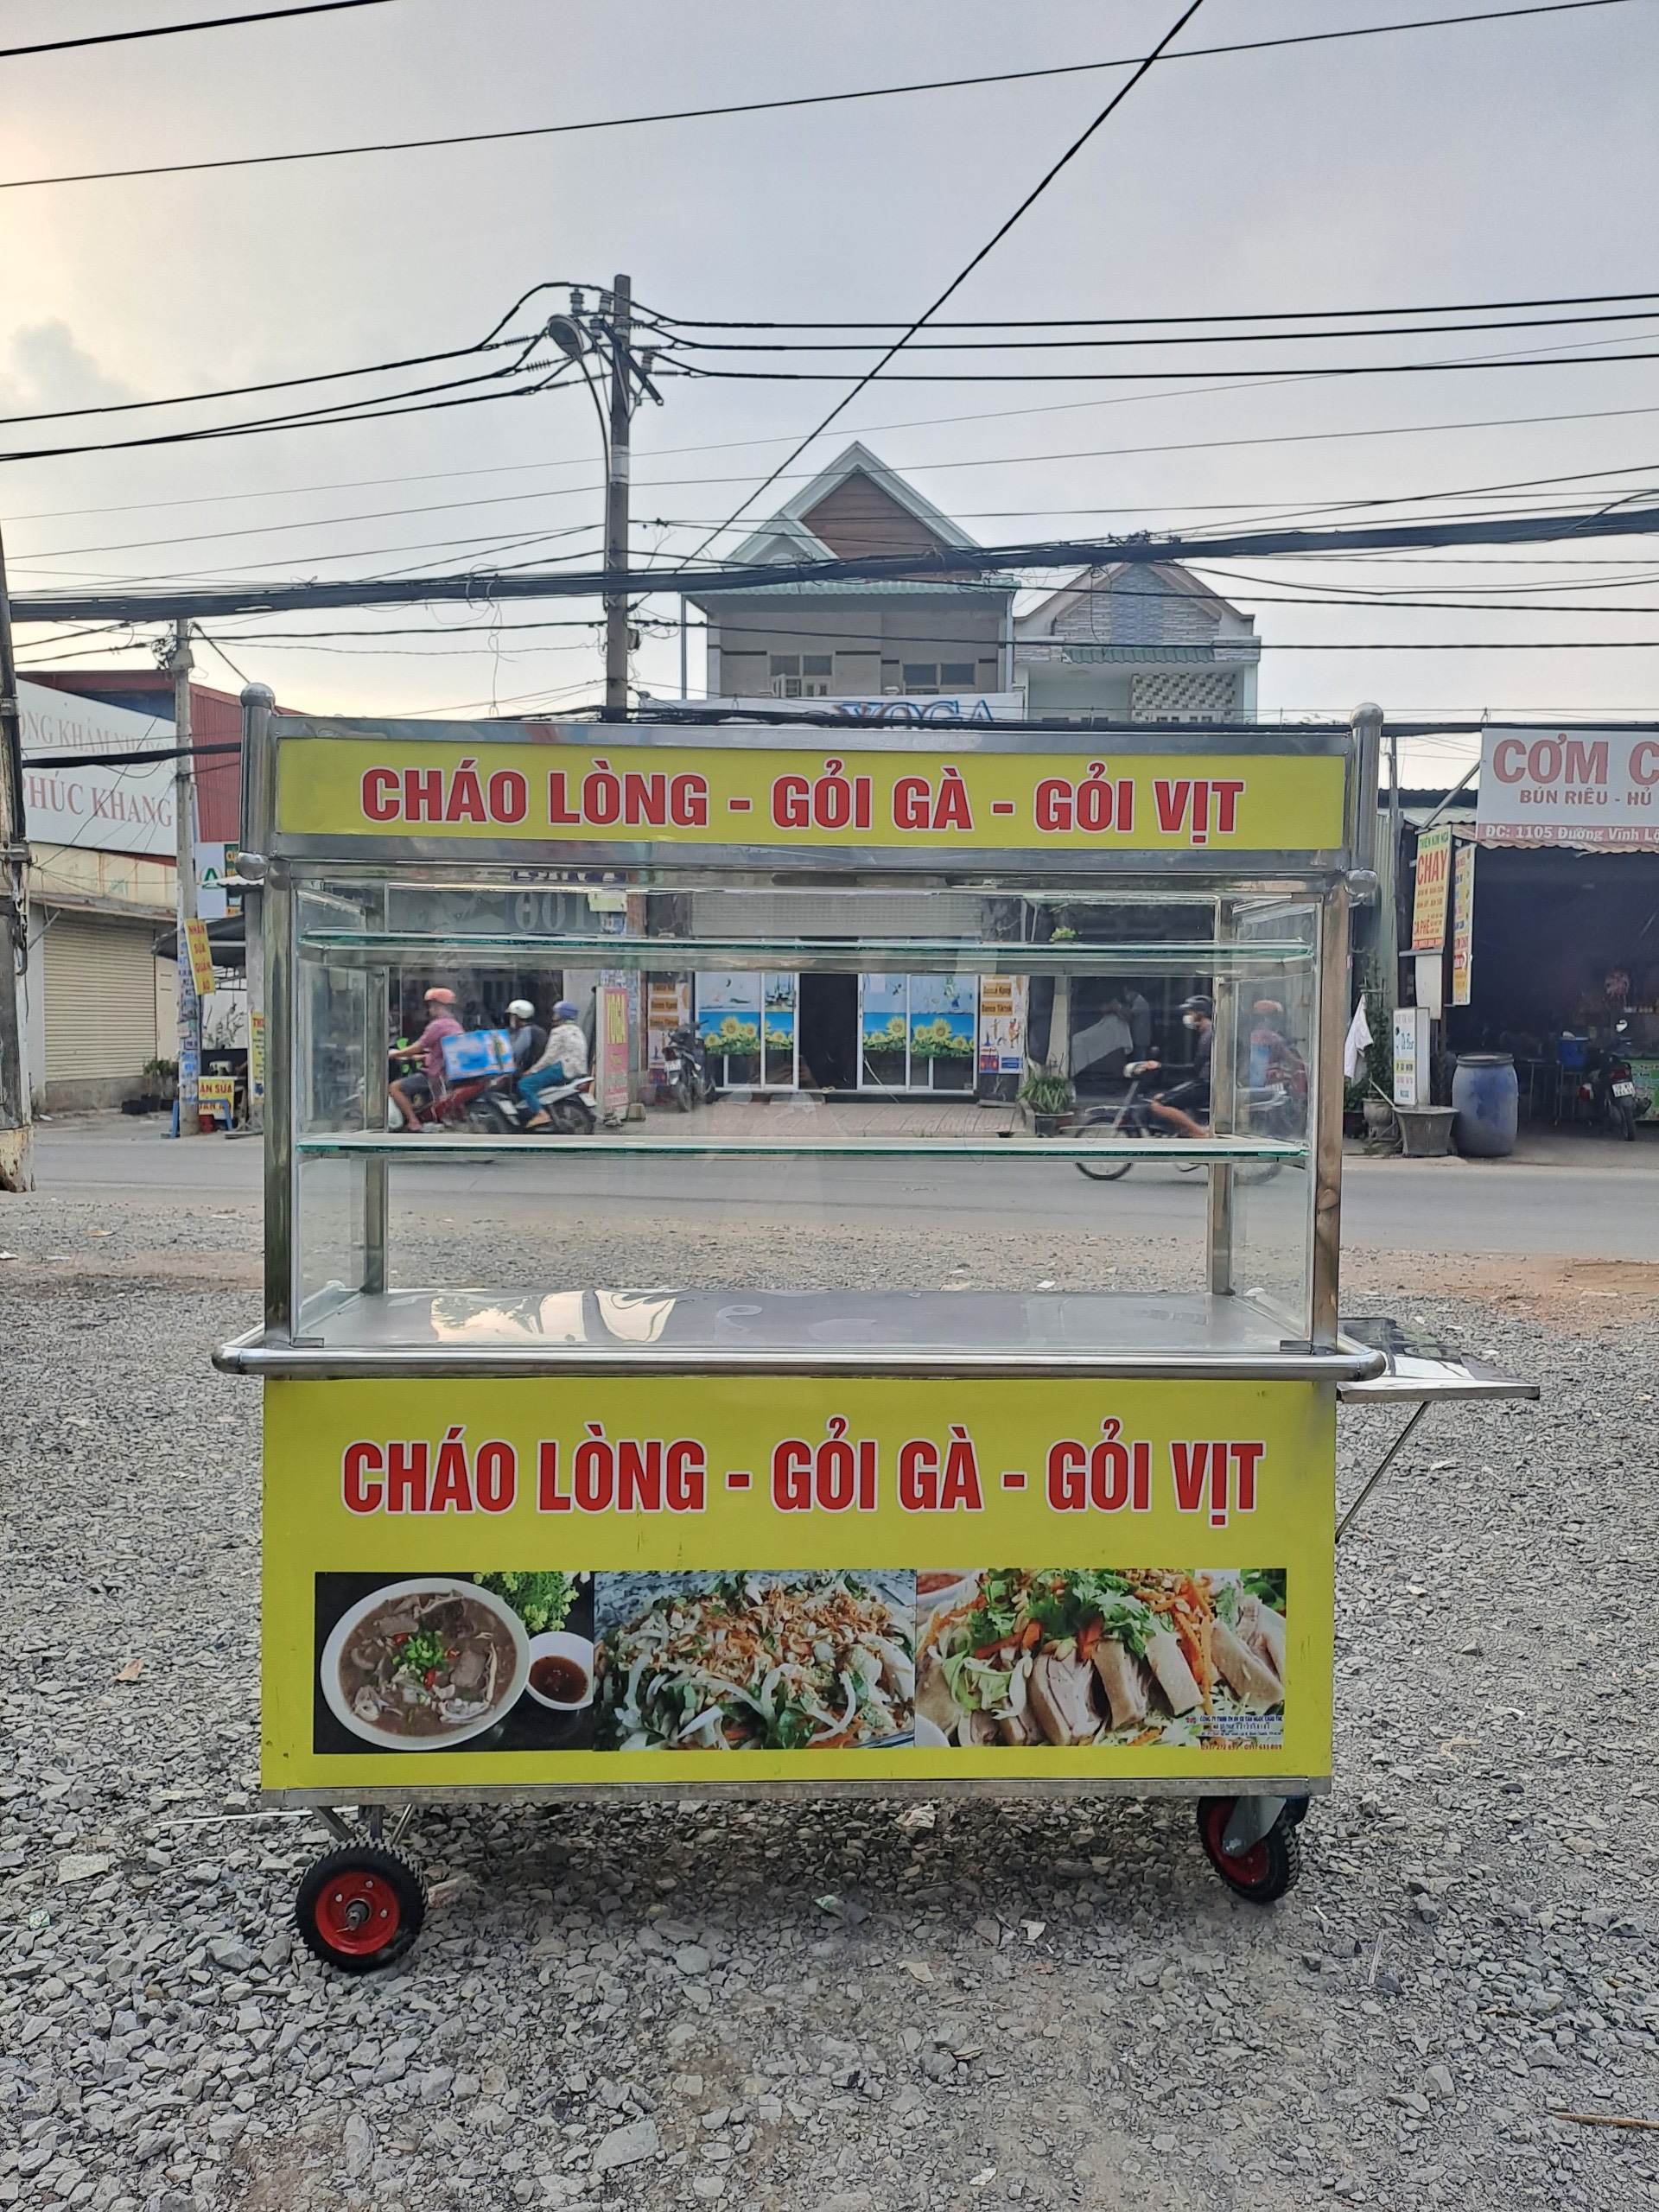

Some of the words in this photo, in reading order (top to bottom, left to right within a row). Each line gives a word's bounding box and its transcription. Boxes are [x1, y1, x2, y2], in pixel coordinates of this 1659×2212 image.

[1492, 733, 1609, 785] CƠM
[90, 786, 172, 828] KHANG
[361, 760, 527, 824] CHÁO
[550, 760, 708, 828] LÒNG
[772, 757, 872, 829] GỎI
[892, 766, 974, 831] GÀ
[1034, 760, 1134, 834] GỎI
[1154, 780, 1244, 845] VỊT
[1520, 785, 1558, 804] BÚN
[1627, 786, 1652, 806] HỦ
[1485, 824, 1511, 838] ĐC:
[1516, 825, 1554, 839] 1105
[1557, 826, 1604, 842] Đường
[1608, 827, 1640, 842] Vĩnh
[1418, 849, 1448, 886] CHAY
[343, 1426, 516, 1516] CHÁO
[538, 1423, 705, 1515] LÒNG
[771, 1416, 877, 1512] GỎI
[899, 1426, 984, 1512] GÀ
[1047, 1417, 1150, 1512] GỎI
[1170, 1442, 1263, 1526] VỊT
